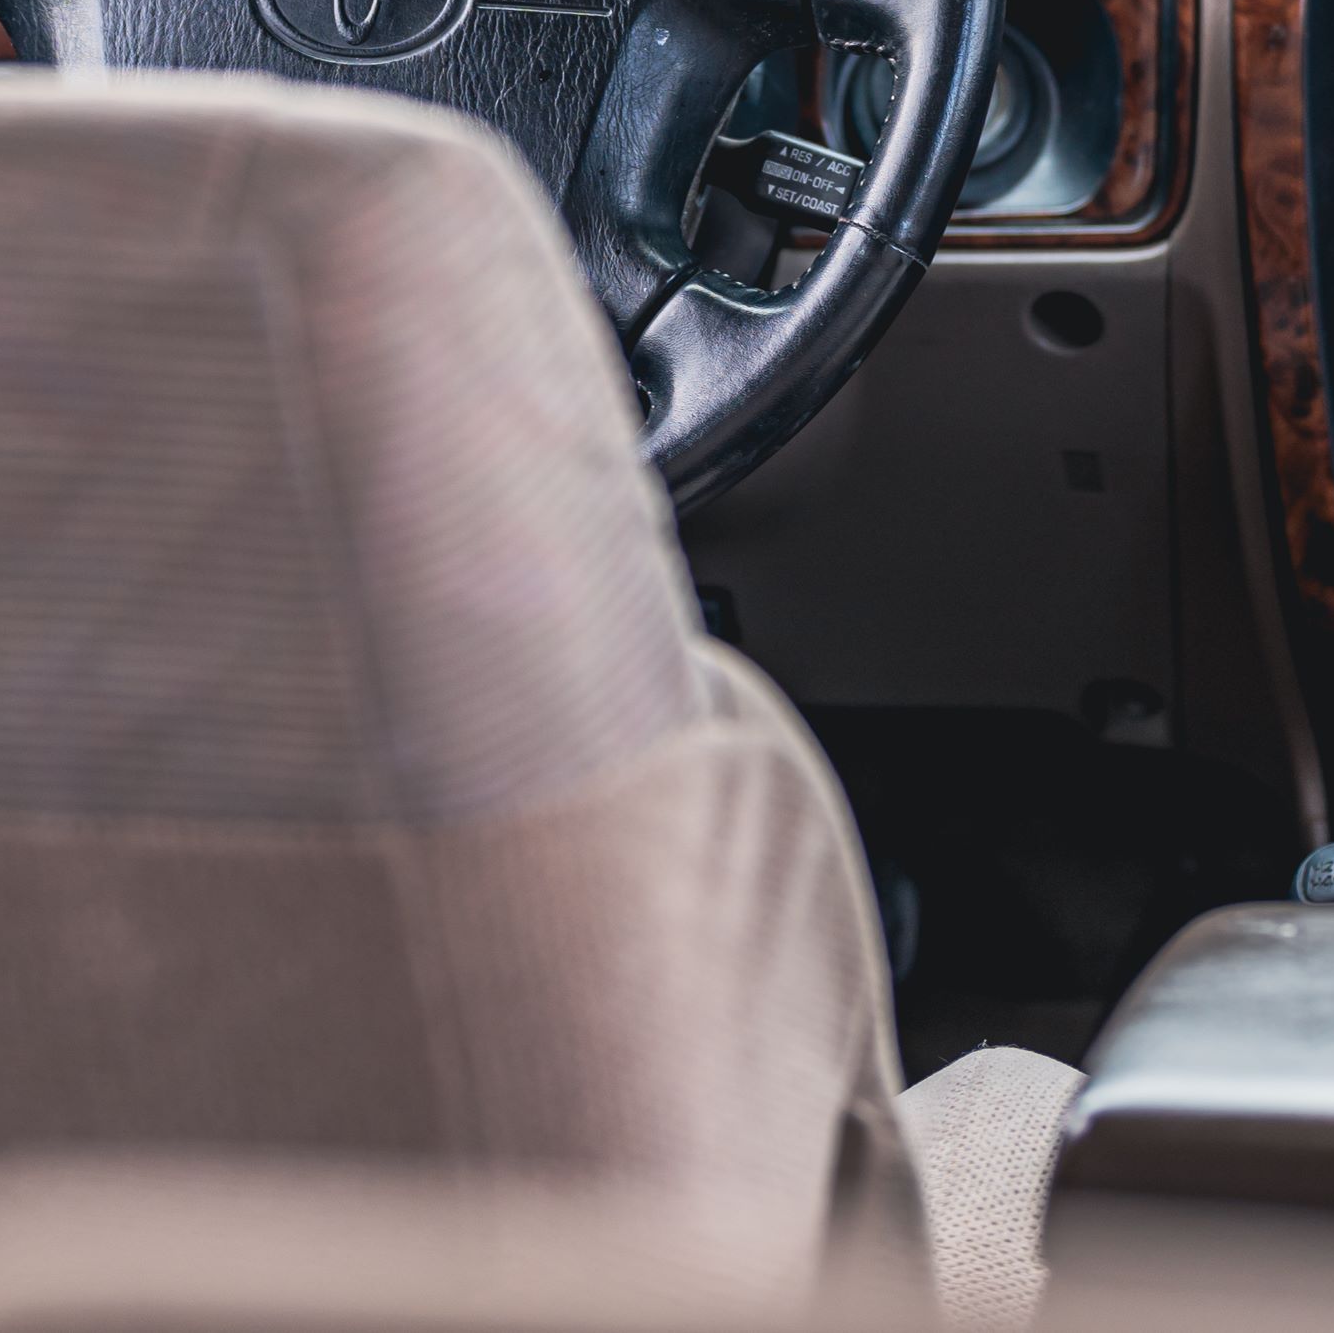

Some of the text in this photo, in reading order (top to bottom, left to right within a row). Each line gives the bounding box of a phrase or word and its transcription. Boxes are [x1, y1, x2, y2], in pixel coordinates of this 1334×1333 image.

[789, 147, 813, 164] RES
[826, 160, 852, 177] ACC
[791, 169, 835, 192] ON-OFF
[775, 186, 840, 216] SET/COAST
